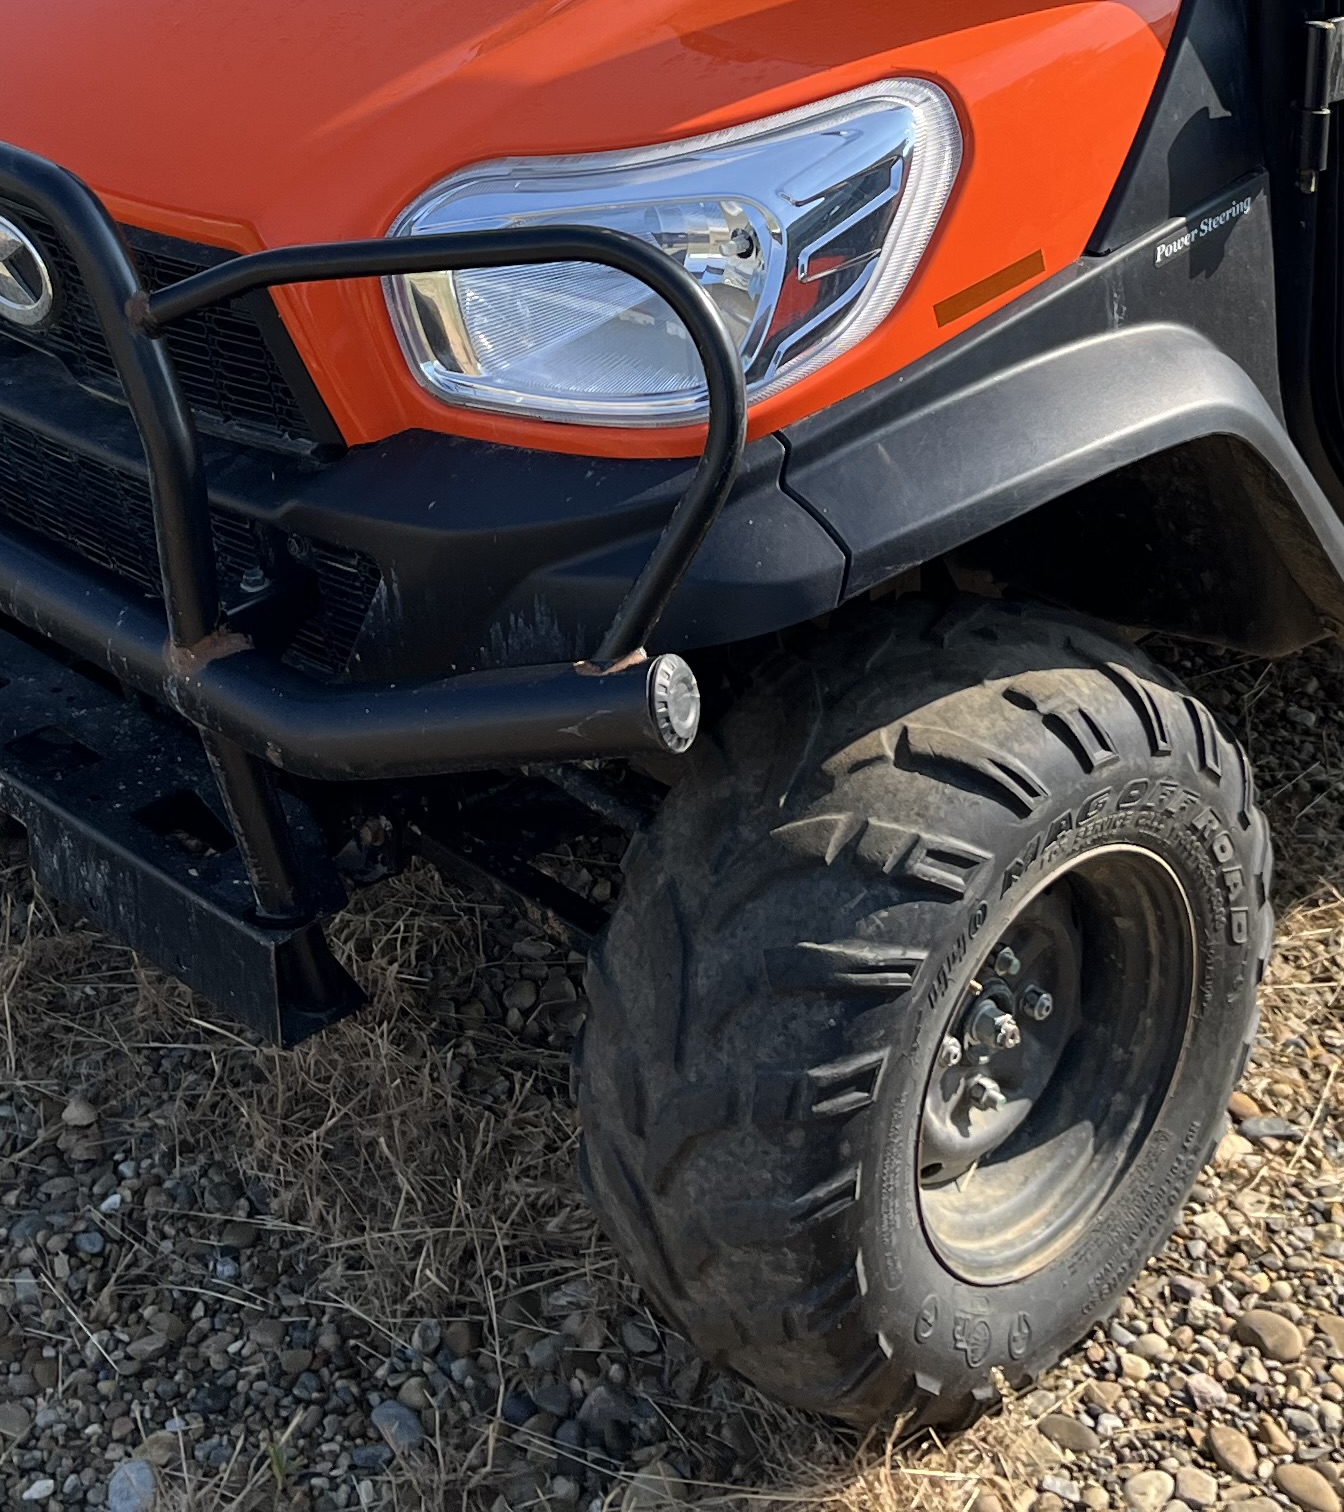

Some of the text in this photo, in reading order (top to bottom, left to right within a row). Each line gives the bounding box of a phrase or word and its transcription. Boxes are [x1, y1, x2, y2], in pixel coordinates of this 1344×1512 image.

[1155, 195, 1252, 264] Power Steering
[1191, 806, 1249, 945] ROAD
